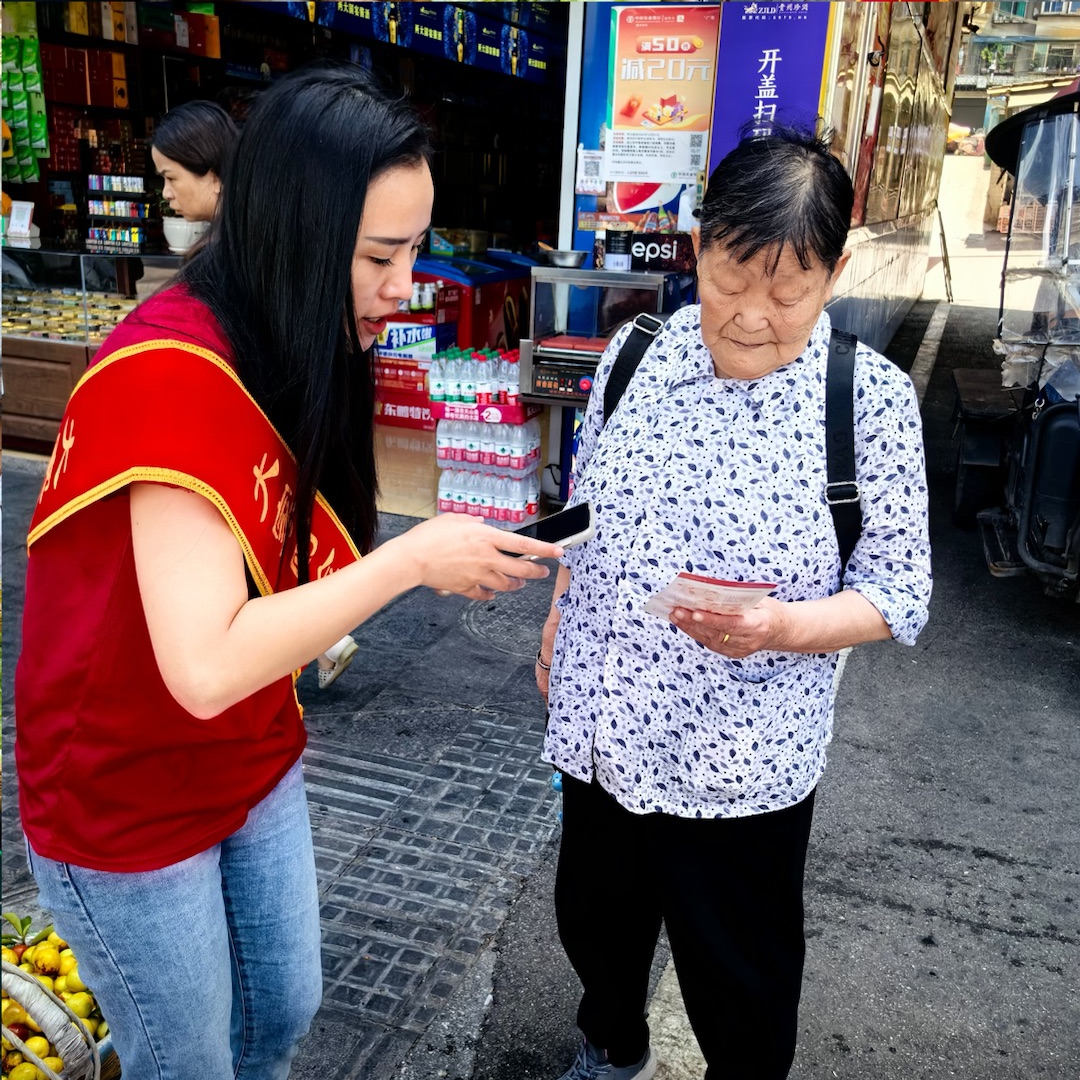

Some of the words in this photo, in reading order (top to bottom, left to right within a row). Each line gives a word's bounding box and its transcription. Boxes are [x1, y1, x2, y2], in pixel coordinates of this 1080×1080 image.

[621, 57, 711, 81] 减20元
[631, 239, 678, 263] epsi
[390, 326, 433, 349] 补水啦
